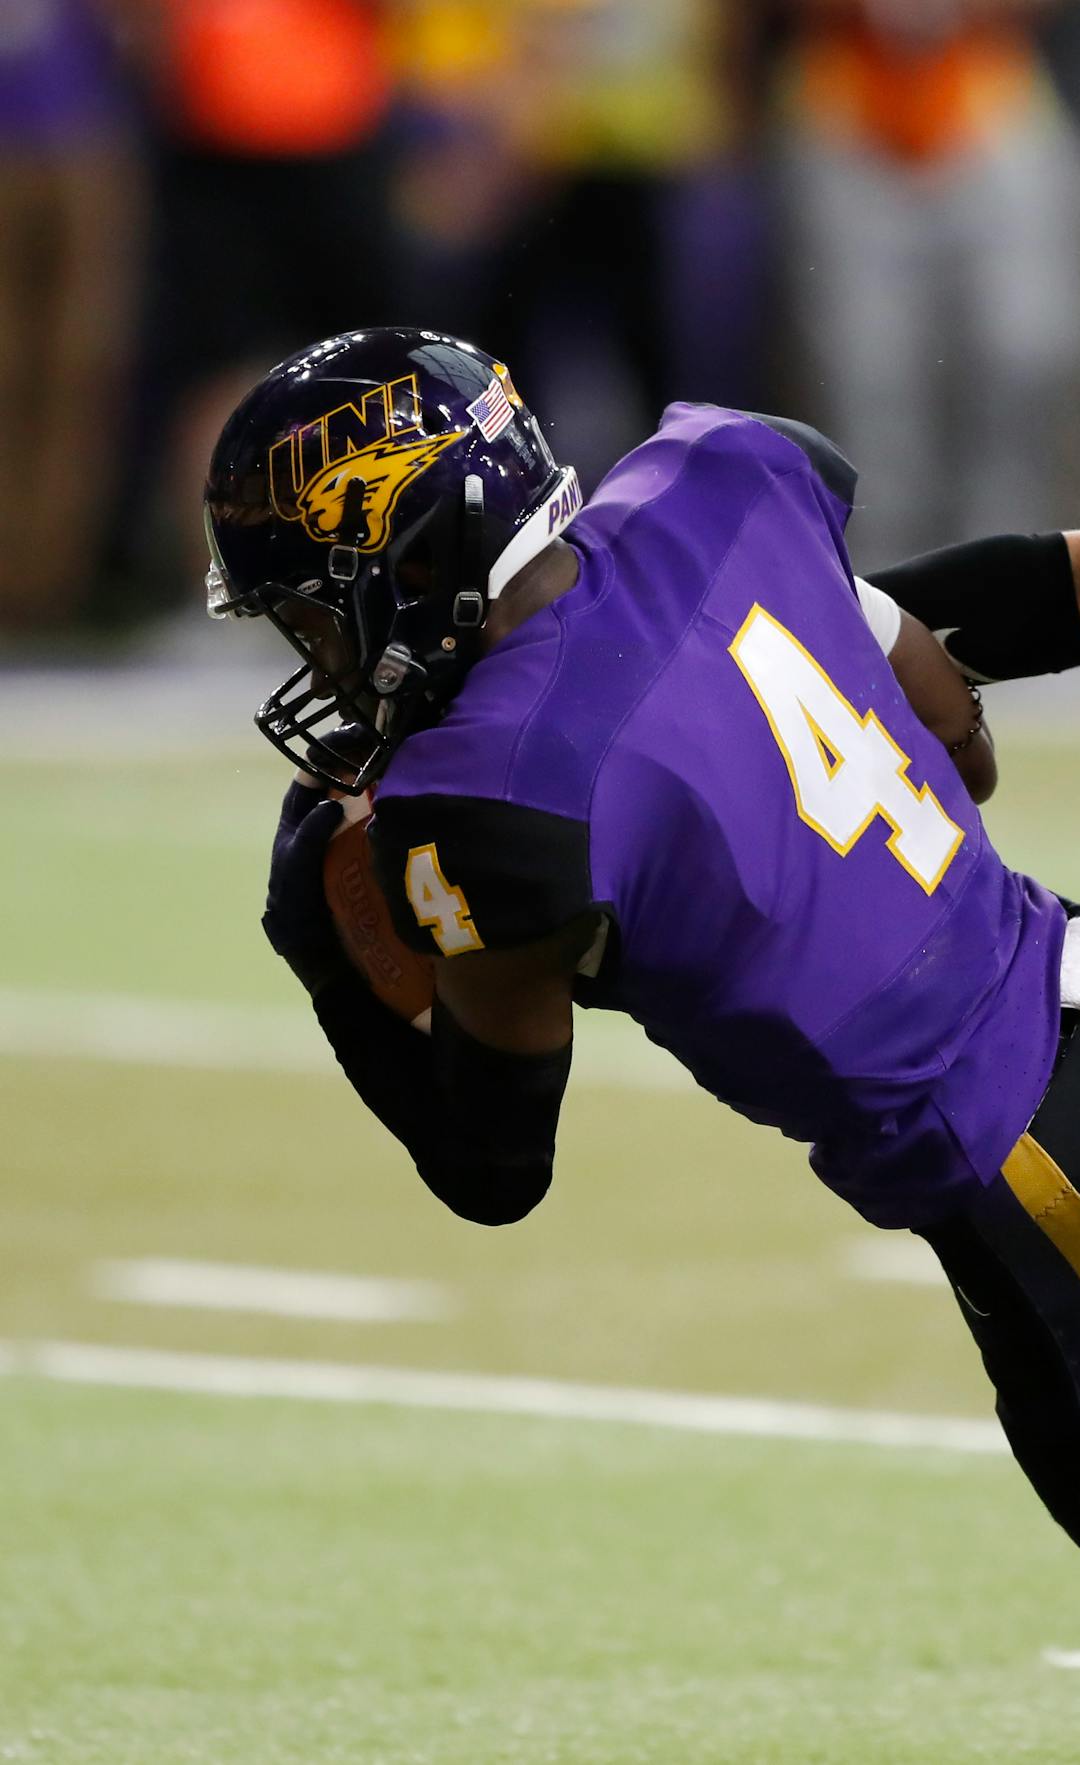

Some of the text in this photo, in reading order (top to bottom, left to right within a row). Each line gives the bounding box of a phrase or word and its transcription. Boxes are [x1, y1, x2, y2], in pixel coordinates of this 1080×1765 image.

[269, 373, 420, 521] UNI
[728, 602, 965, 896] 4
[405, 842, 485, 957] 4
